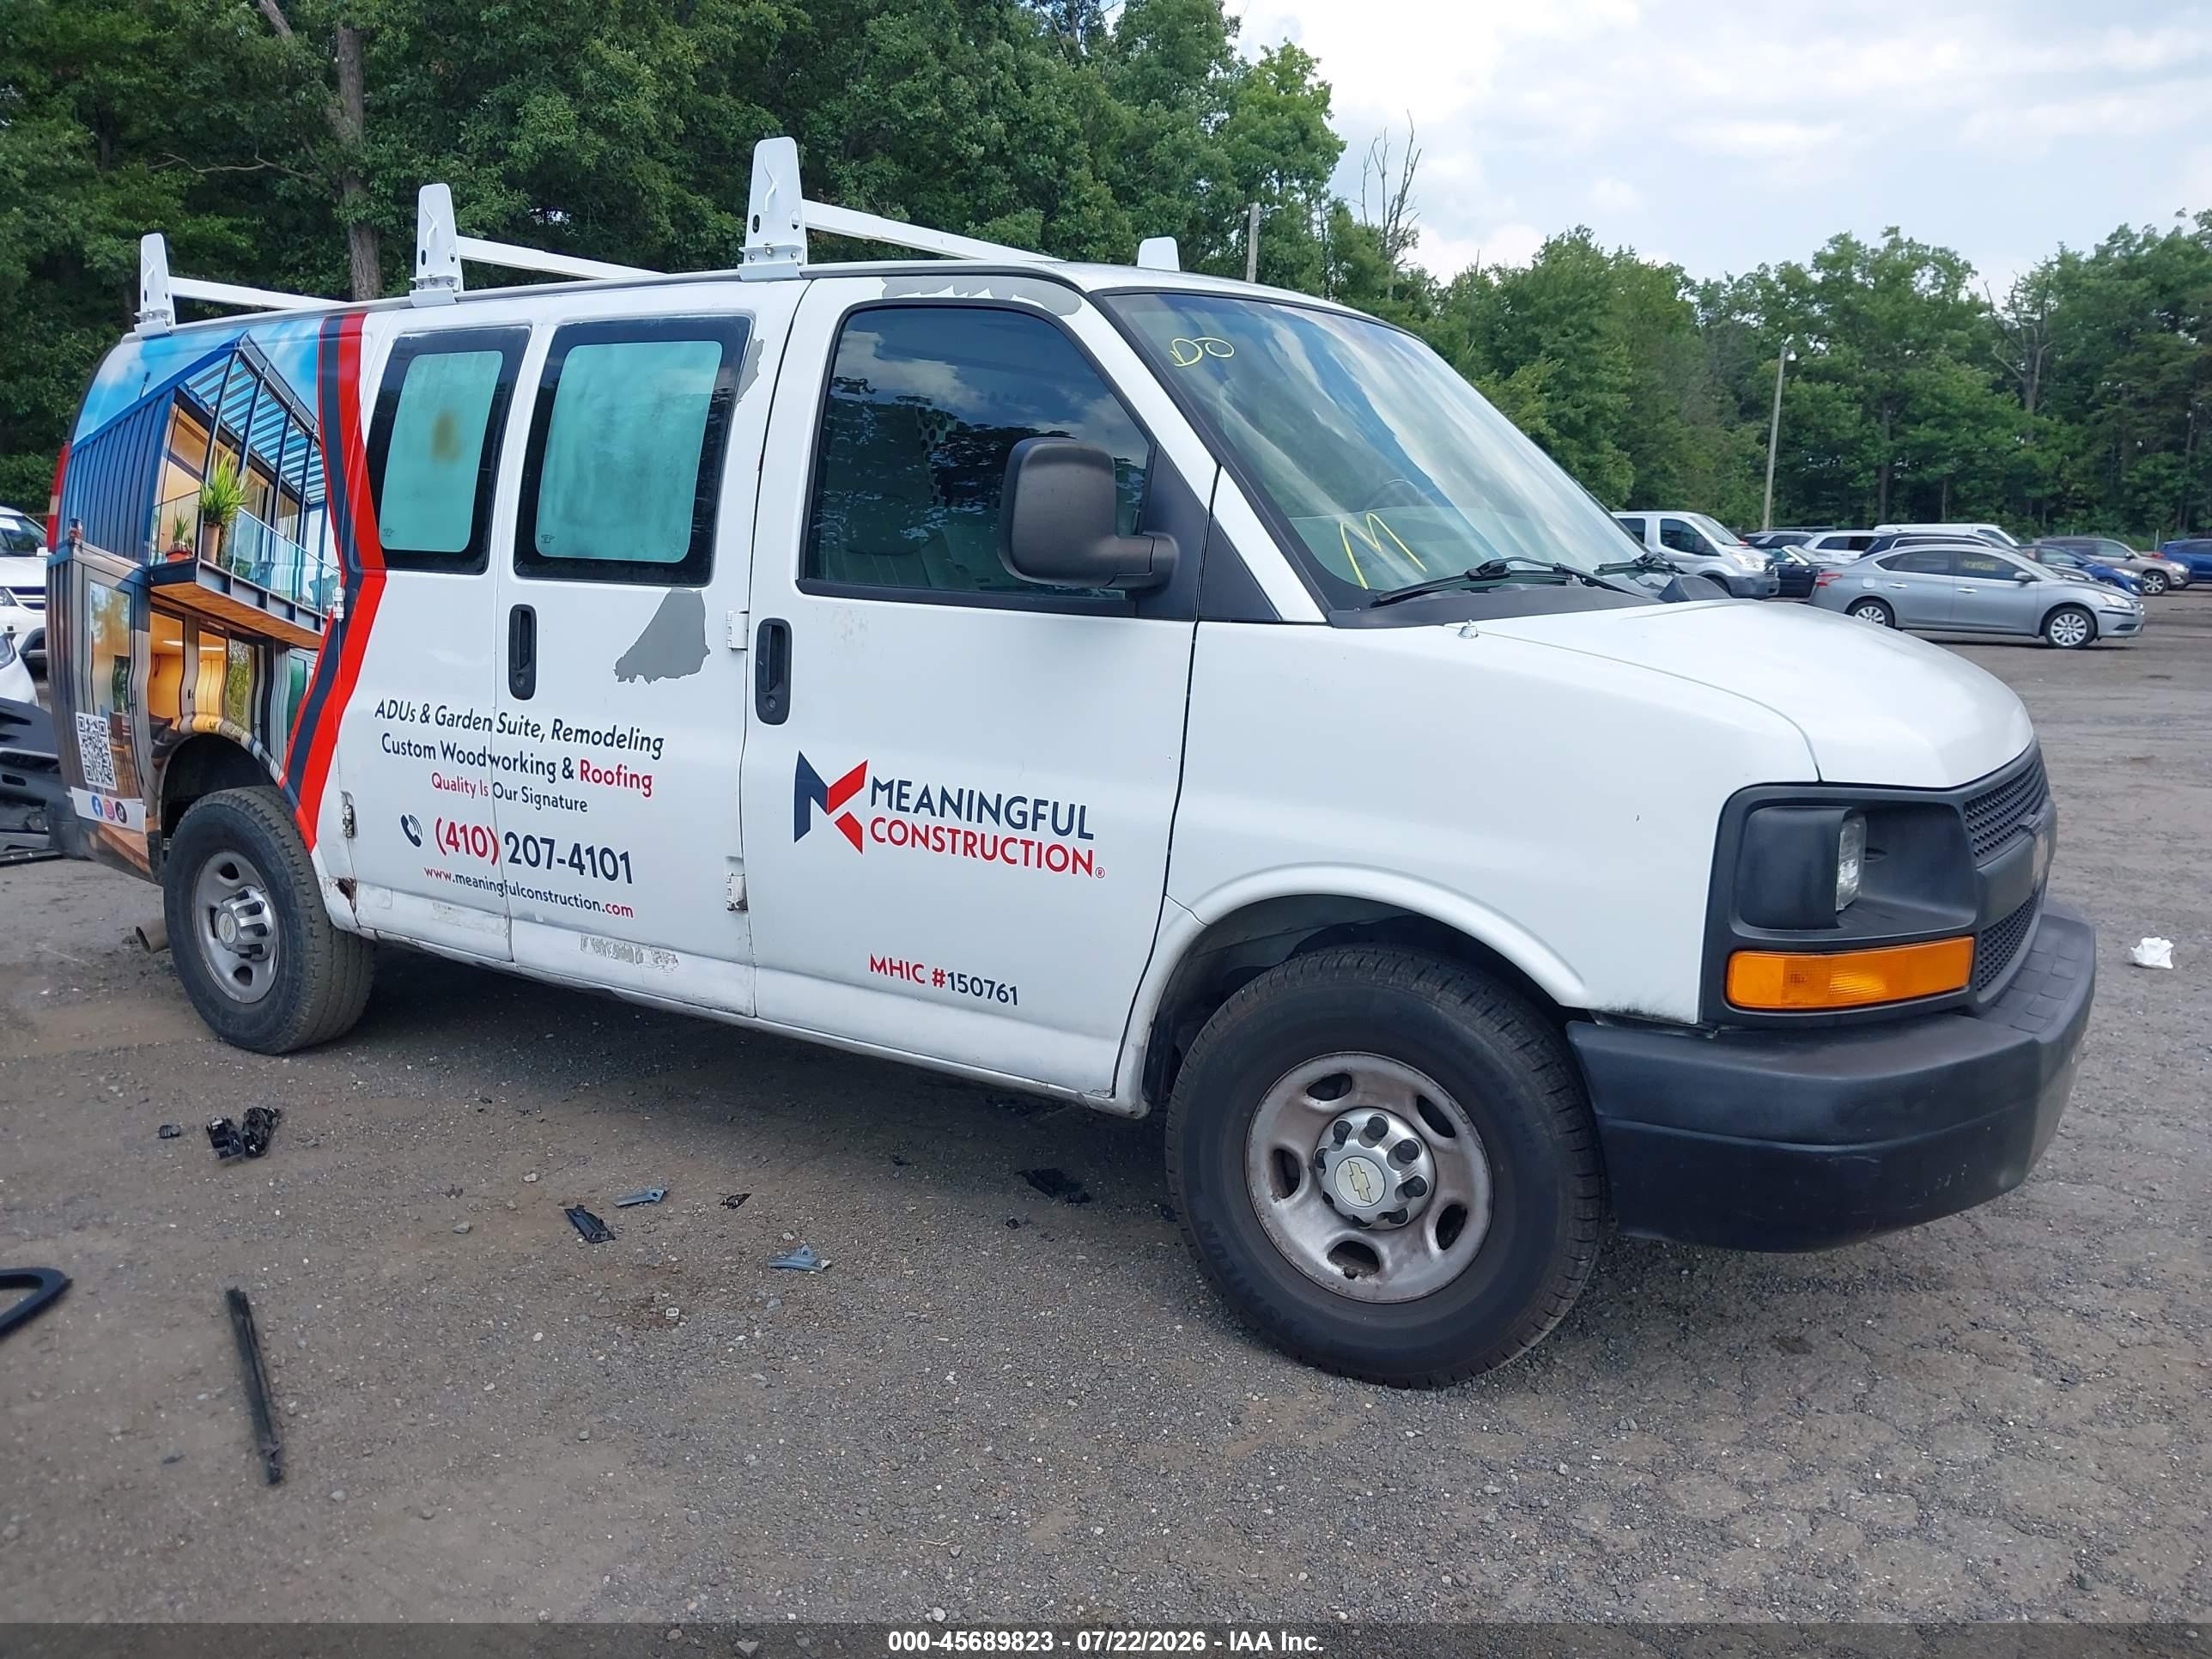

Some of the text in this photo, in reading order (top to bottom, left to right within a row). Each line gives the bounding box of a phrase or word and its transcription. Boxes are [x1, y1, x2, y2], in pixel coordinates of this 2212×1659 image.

[374, 698, 665, 760] ADUs & Garden Suite, Remodeling
[381, 732, 653, 798] Custom Woodworking & Roofing
[431, 772, 588, 814] Quality Is Our Signature
[870, 775, 1095, 841] MEANINGFUL
[434, 816, 634, 885] (410) 207-4101
[423, 866, 635, 919] www.meaningfulconstruction.com
[869, 953, 1019, 1006] MHIC #150761
